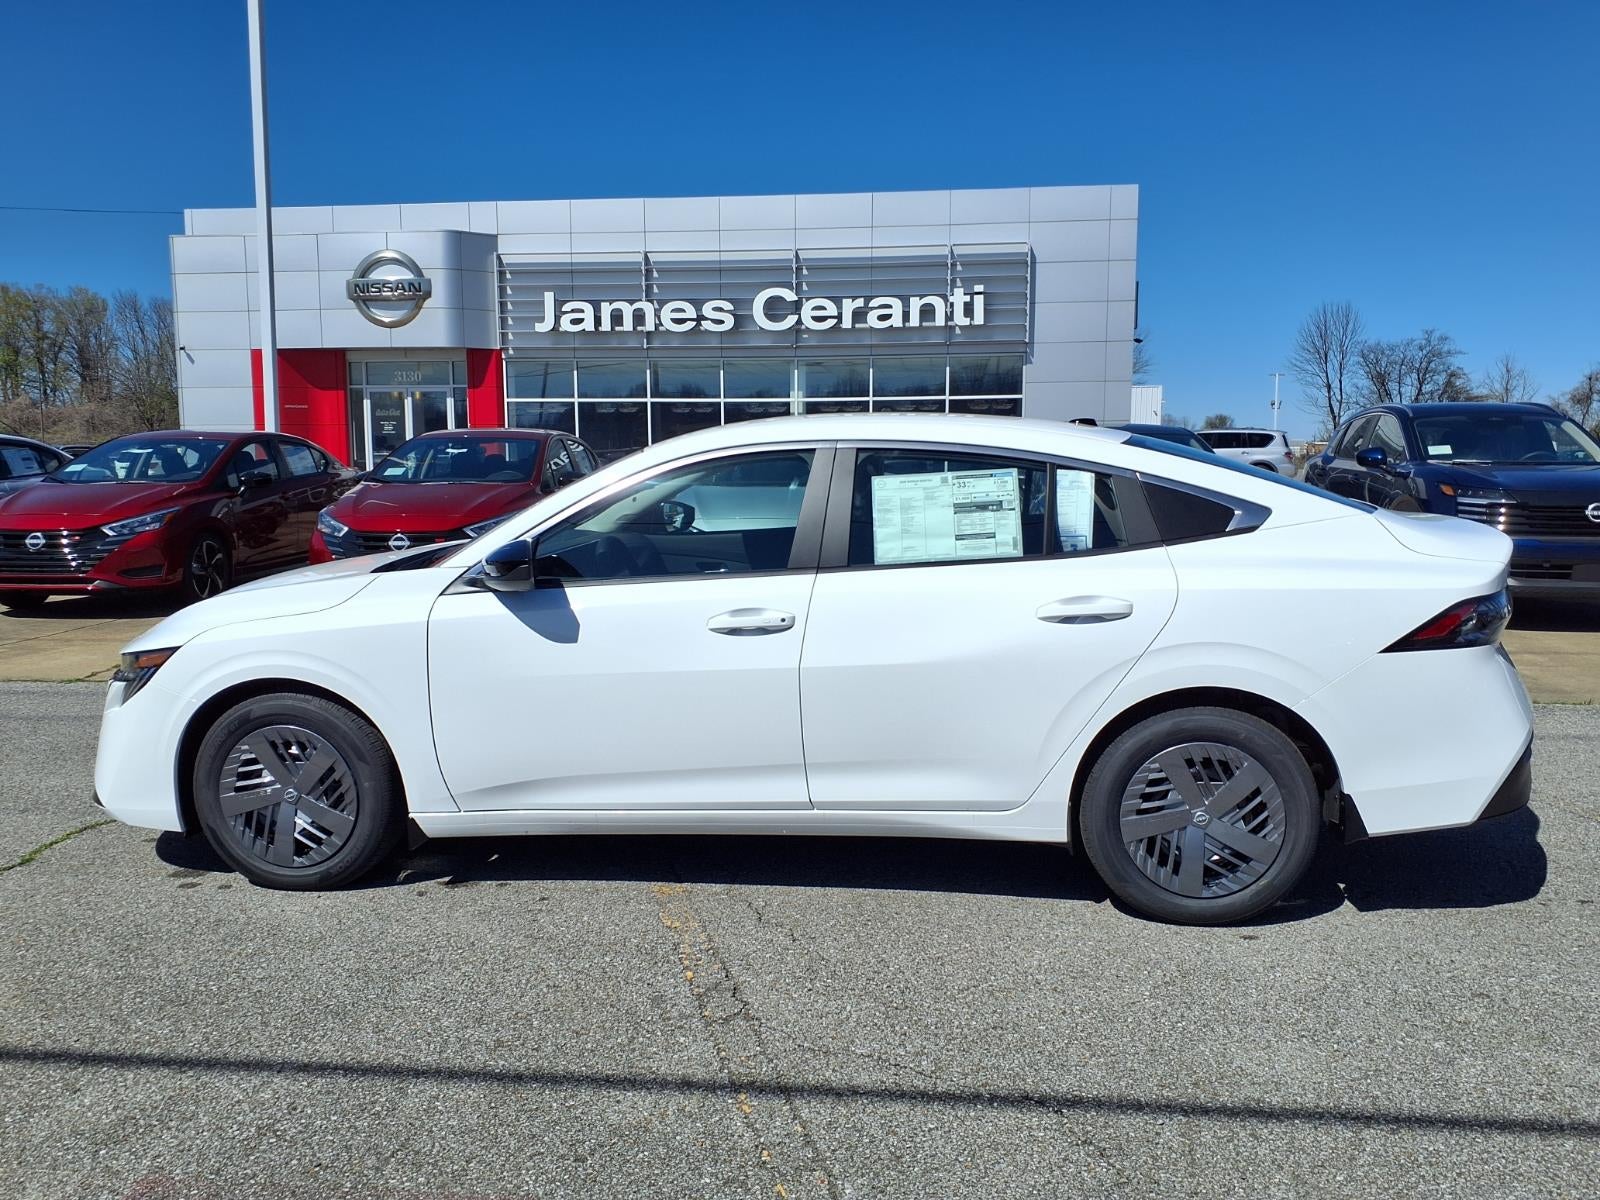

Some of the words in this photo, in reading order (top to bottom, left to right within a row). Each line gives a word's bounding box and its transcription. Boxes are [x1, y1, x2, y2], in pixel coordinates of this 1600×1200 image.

[353, 282, 422, 295] NISSAN
[534, 291, 735, 333] James
[752, 284, 985, 331] Ceranti
